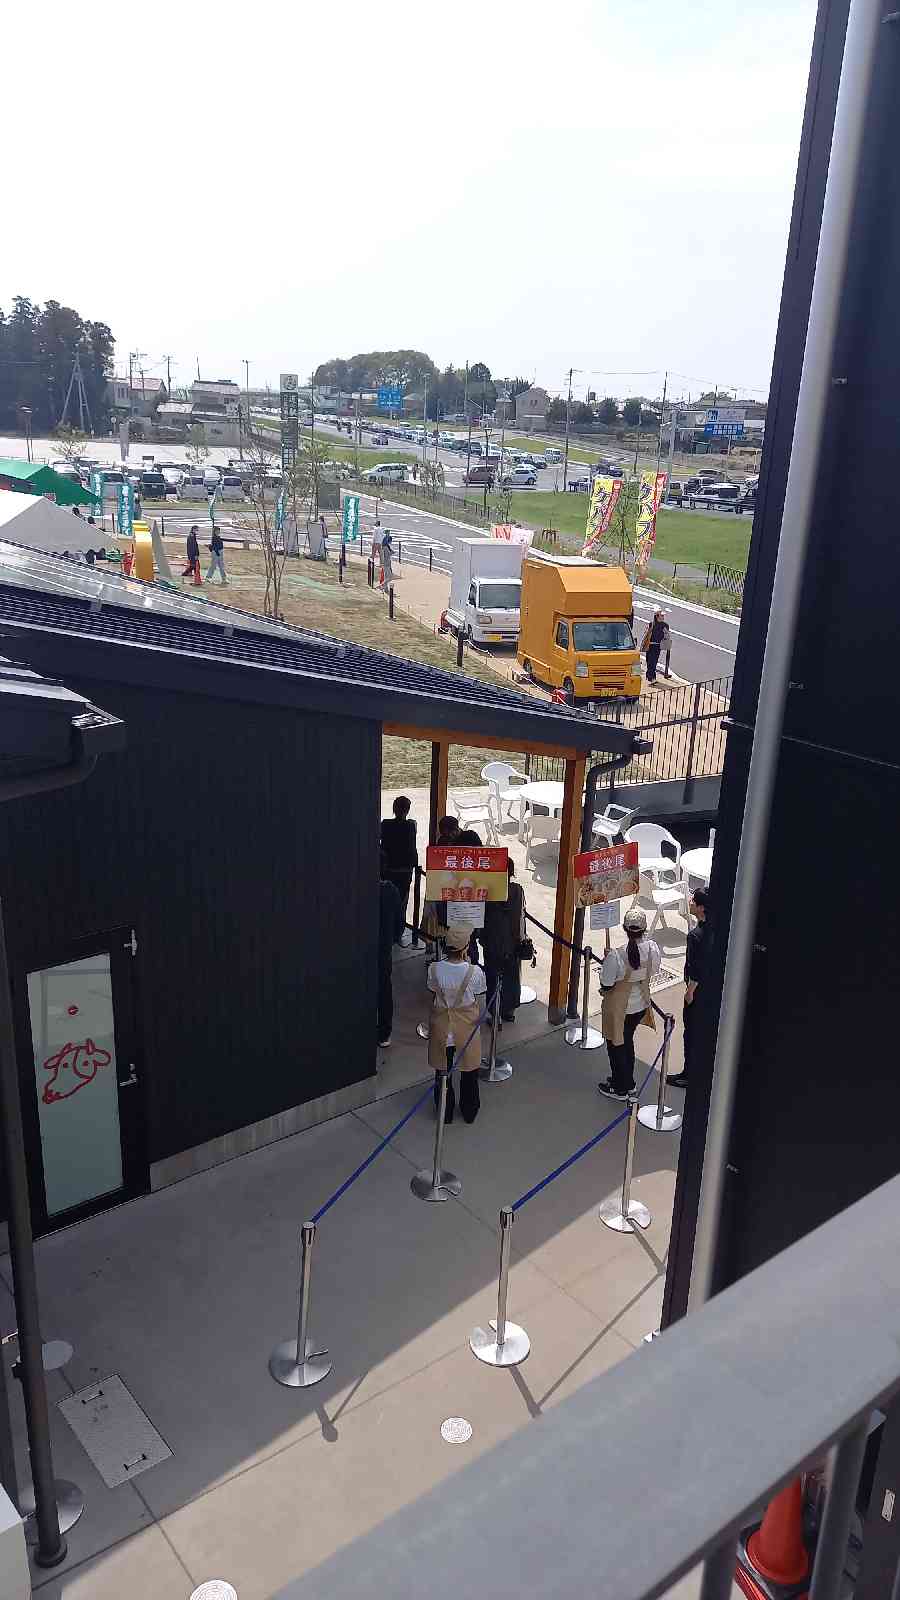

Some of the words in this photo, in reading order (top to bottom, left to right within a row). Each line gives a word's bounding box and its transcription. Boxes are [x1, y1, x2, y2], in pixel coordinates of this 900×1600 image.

[445, 855, 491, 869] 最後尾
[589, 853, 625, 873] 最後尾
